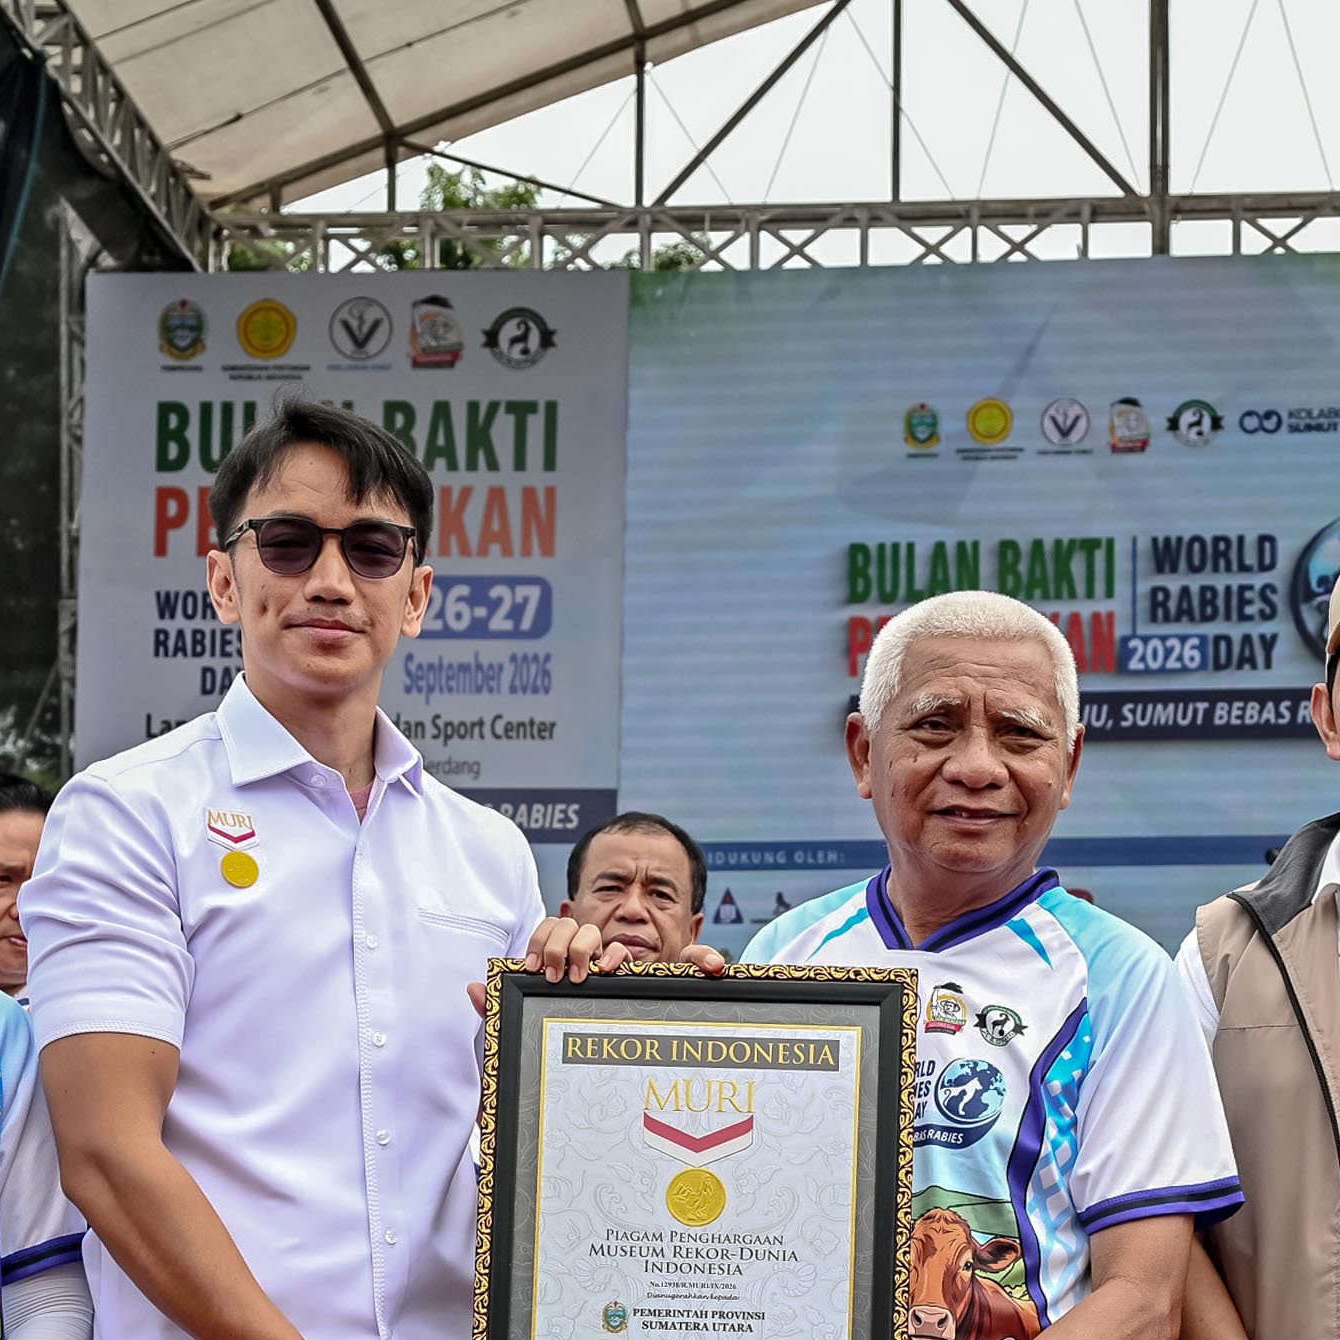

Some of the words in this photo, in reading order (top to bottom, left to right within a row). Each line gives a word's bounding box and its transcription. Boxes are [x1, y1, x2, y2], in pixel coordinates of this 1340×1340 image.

[1151, 533, 1278, 575] WORLD
[848, 541, 981, 604] BULAN
[999, 536, 1116, 600] BAKTI
[428, 584, 542, 632] 26-27
[1149, 584, 1279, 625] RABIES
[153, 628, 243, 658] RABIE
[1127, 638, 1201, 671] 2026
[1213, 632, 1278, 672] DAY
[200, 666, 242, 696] DA
[404, 652, 504, 704] September
[509, 655, 552, 696] 2026
[1121, 702, 1209, 727] SUMUT
[1214, 700, 1292, 726] BEBAS
[431, 713, 485, 747] Sport
[490, 713, 556, 741] Center
[424, 754, 480, 781] erdang
[207, 809, 254, 830] MURI
[566, 1036, 661, 1062] REKOR
[670, 1039, 836, 1066] INDONESIA
[916, 1059, 936, 1078] RLD
[643, 1077, 756, 1113] MURI
[915, 1100, 928, 1119] AY
[927, 1129, 964, 1144] RABIES
[605, 1228, 664, 1244] PIAGAM
[669, 1229, 784, 1246] PENGHARGAAN
[588, 1243, 665, 1259] MUSEUM
[672, 1244, 799, 1263] REKOR-DUNIA
[643, 1259, 743, 1276] INDONESIA
[633, 1307, 709, 1320] PEMERINTAH
[711, 1309, 766, 1321] PROVINSI
[641, 1319, 710, 1332] SUMATERA
[712, 1320, 754, 1333] UTARA
